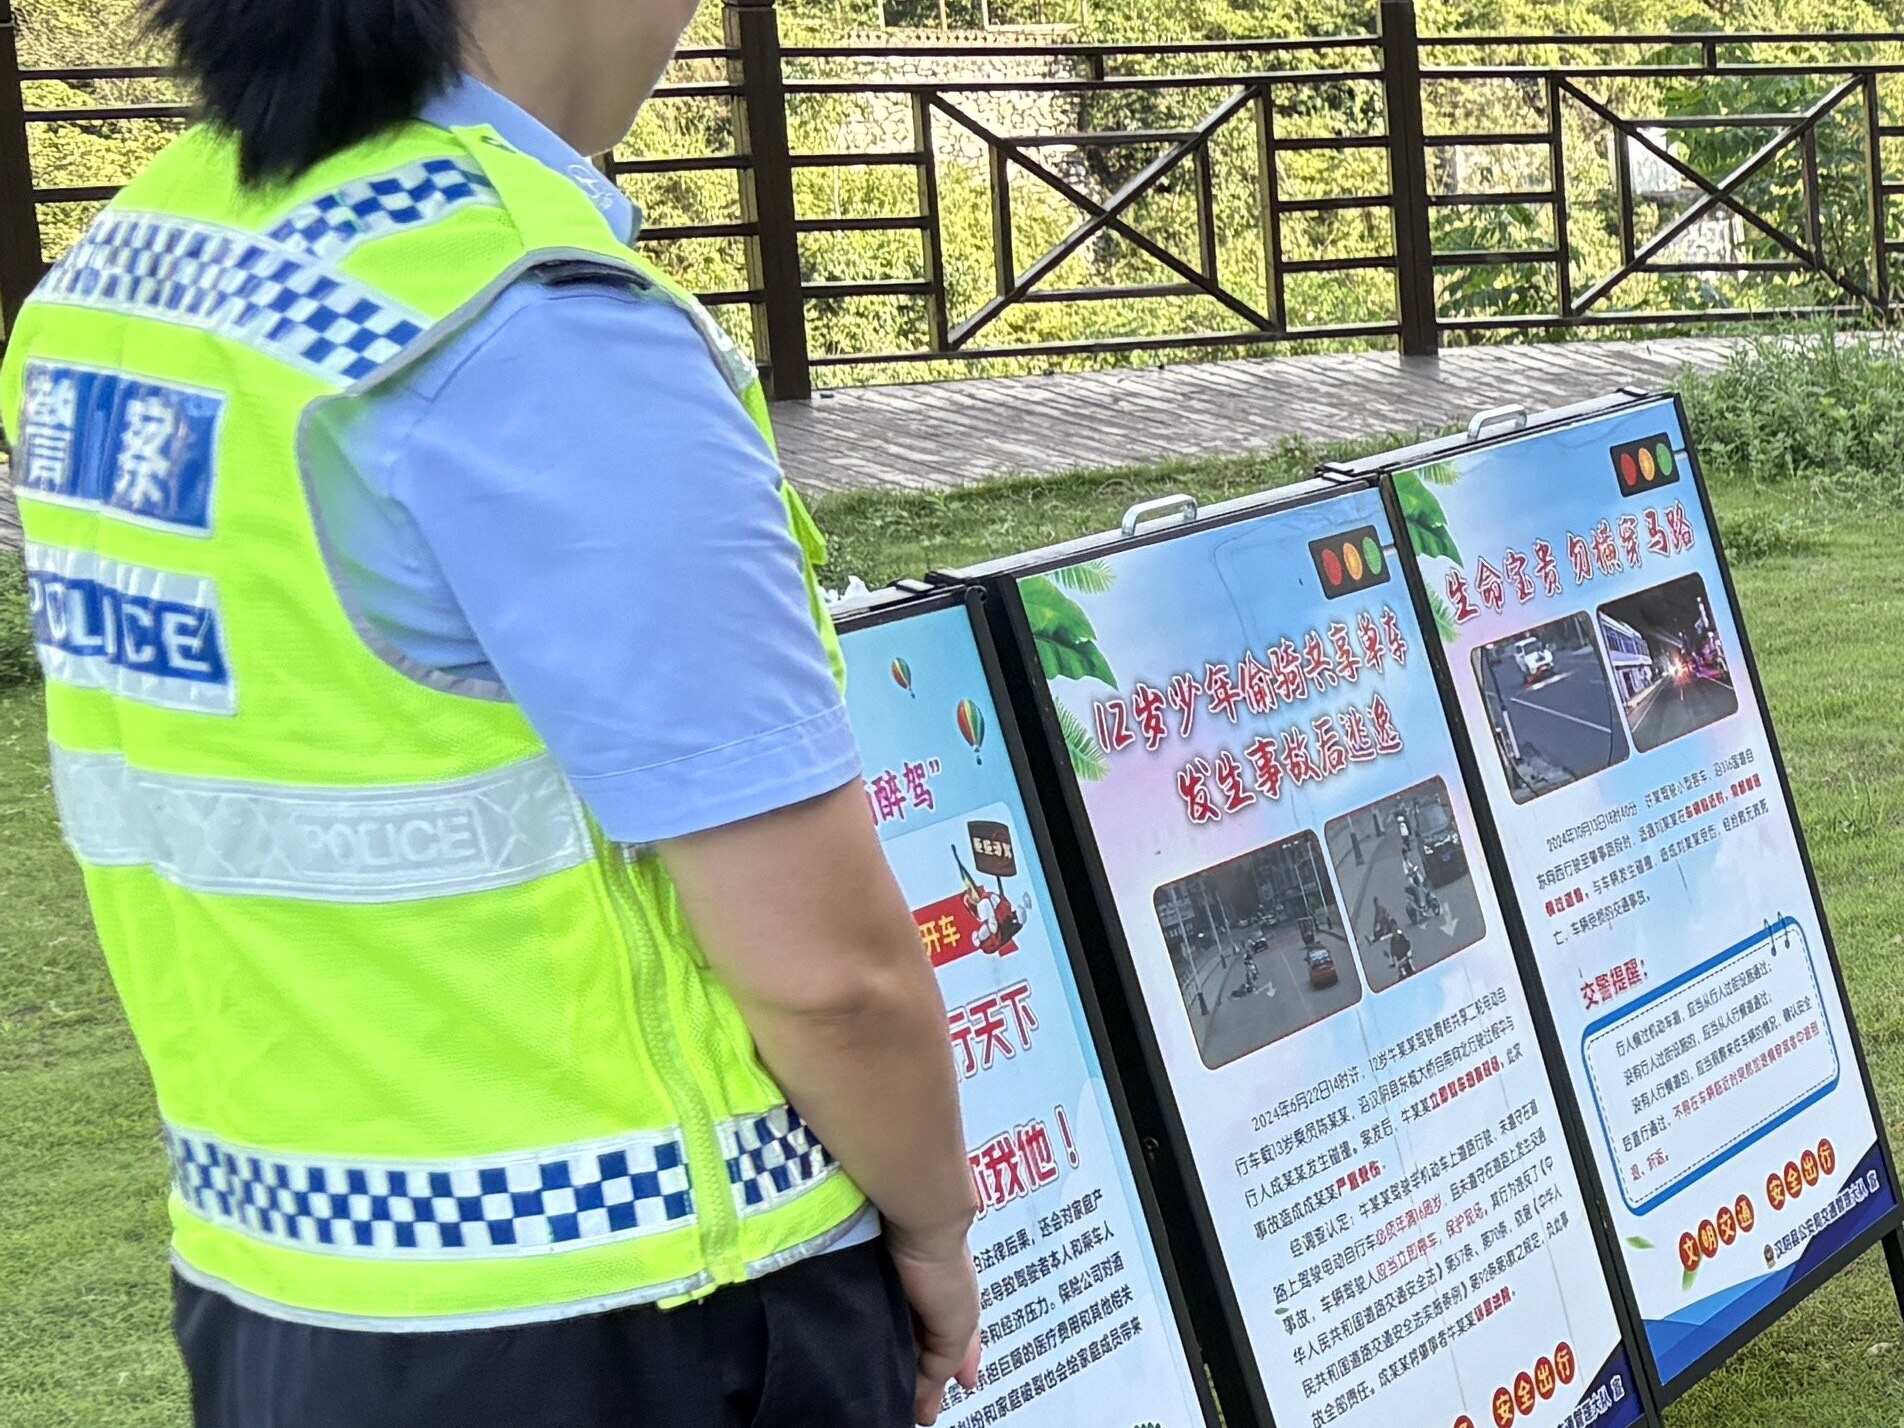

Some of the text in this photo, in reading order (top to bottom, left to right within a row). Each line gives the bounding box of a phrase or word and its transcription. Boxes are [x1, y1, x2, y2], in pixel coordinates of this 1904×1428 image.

[25, 368, 174, 508] 警察
[1440, 494, 1697, 625] 生命宝贵 勿横穿马路
[1089, 608, 1410, 755] 12岁少年偷骑共享单车
[860, 752, 951, 827] 醉驾”
[1173, 692, 1404, 828] 发生事故后逃逸
[302, 814, 478, 866] POLICE
[1578, 952, 1649, 1011] 交警提醒：
[1679, 1138, 1836, 1271] 文明交通 安全出行
